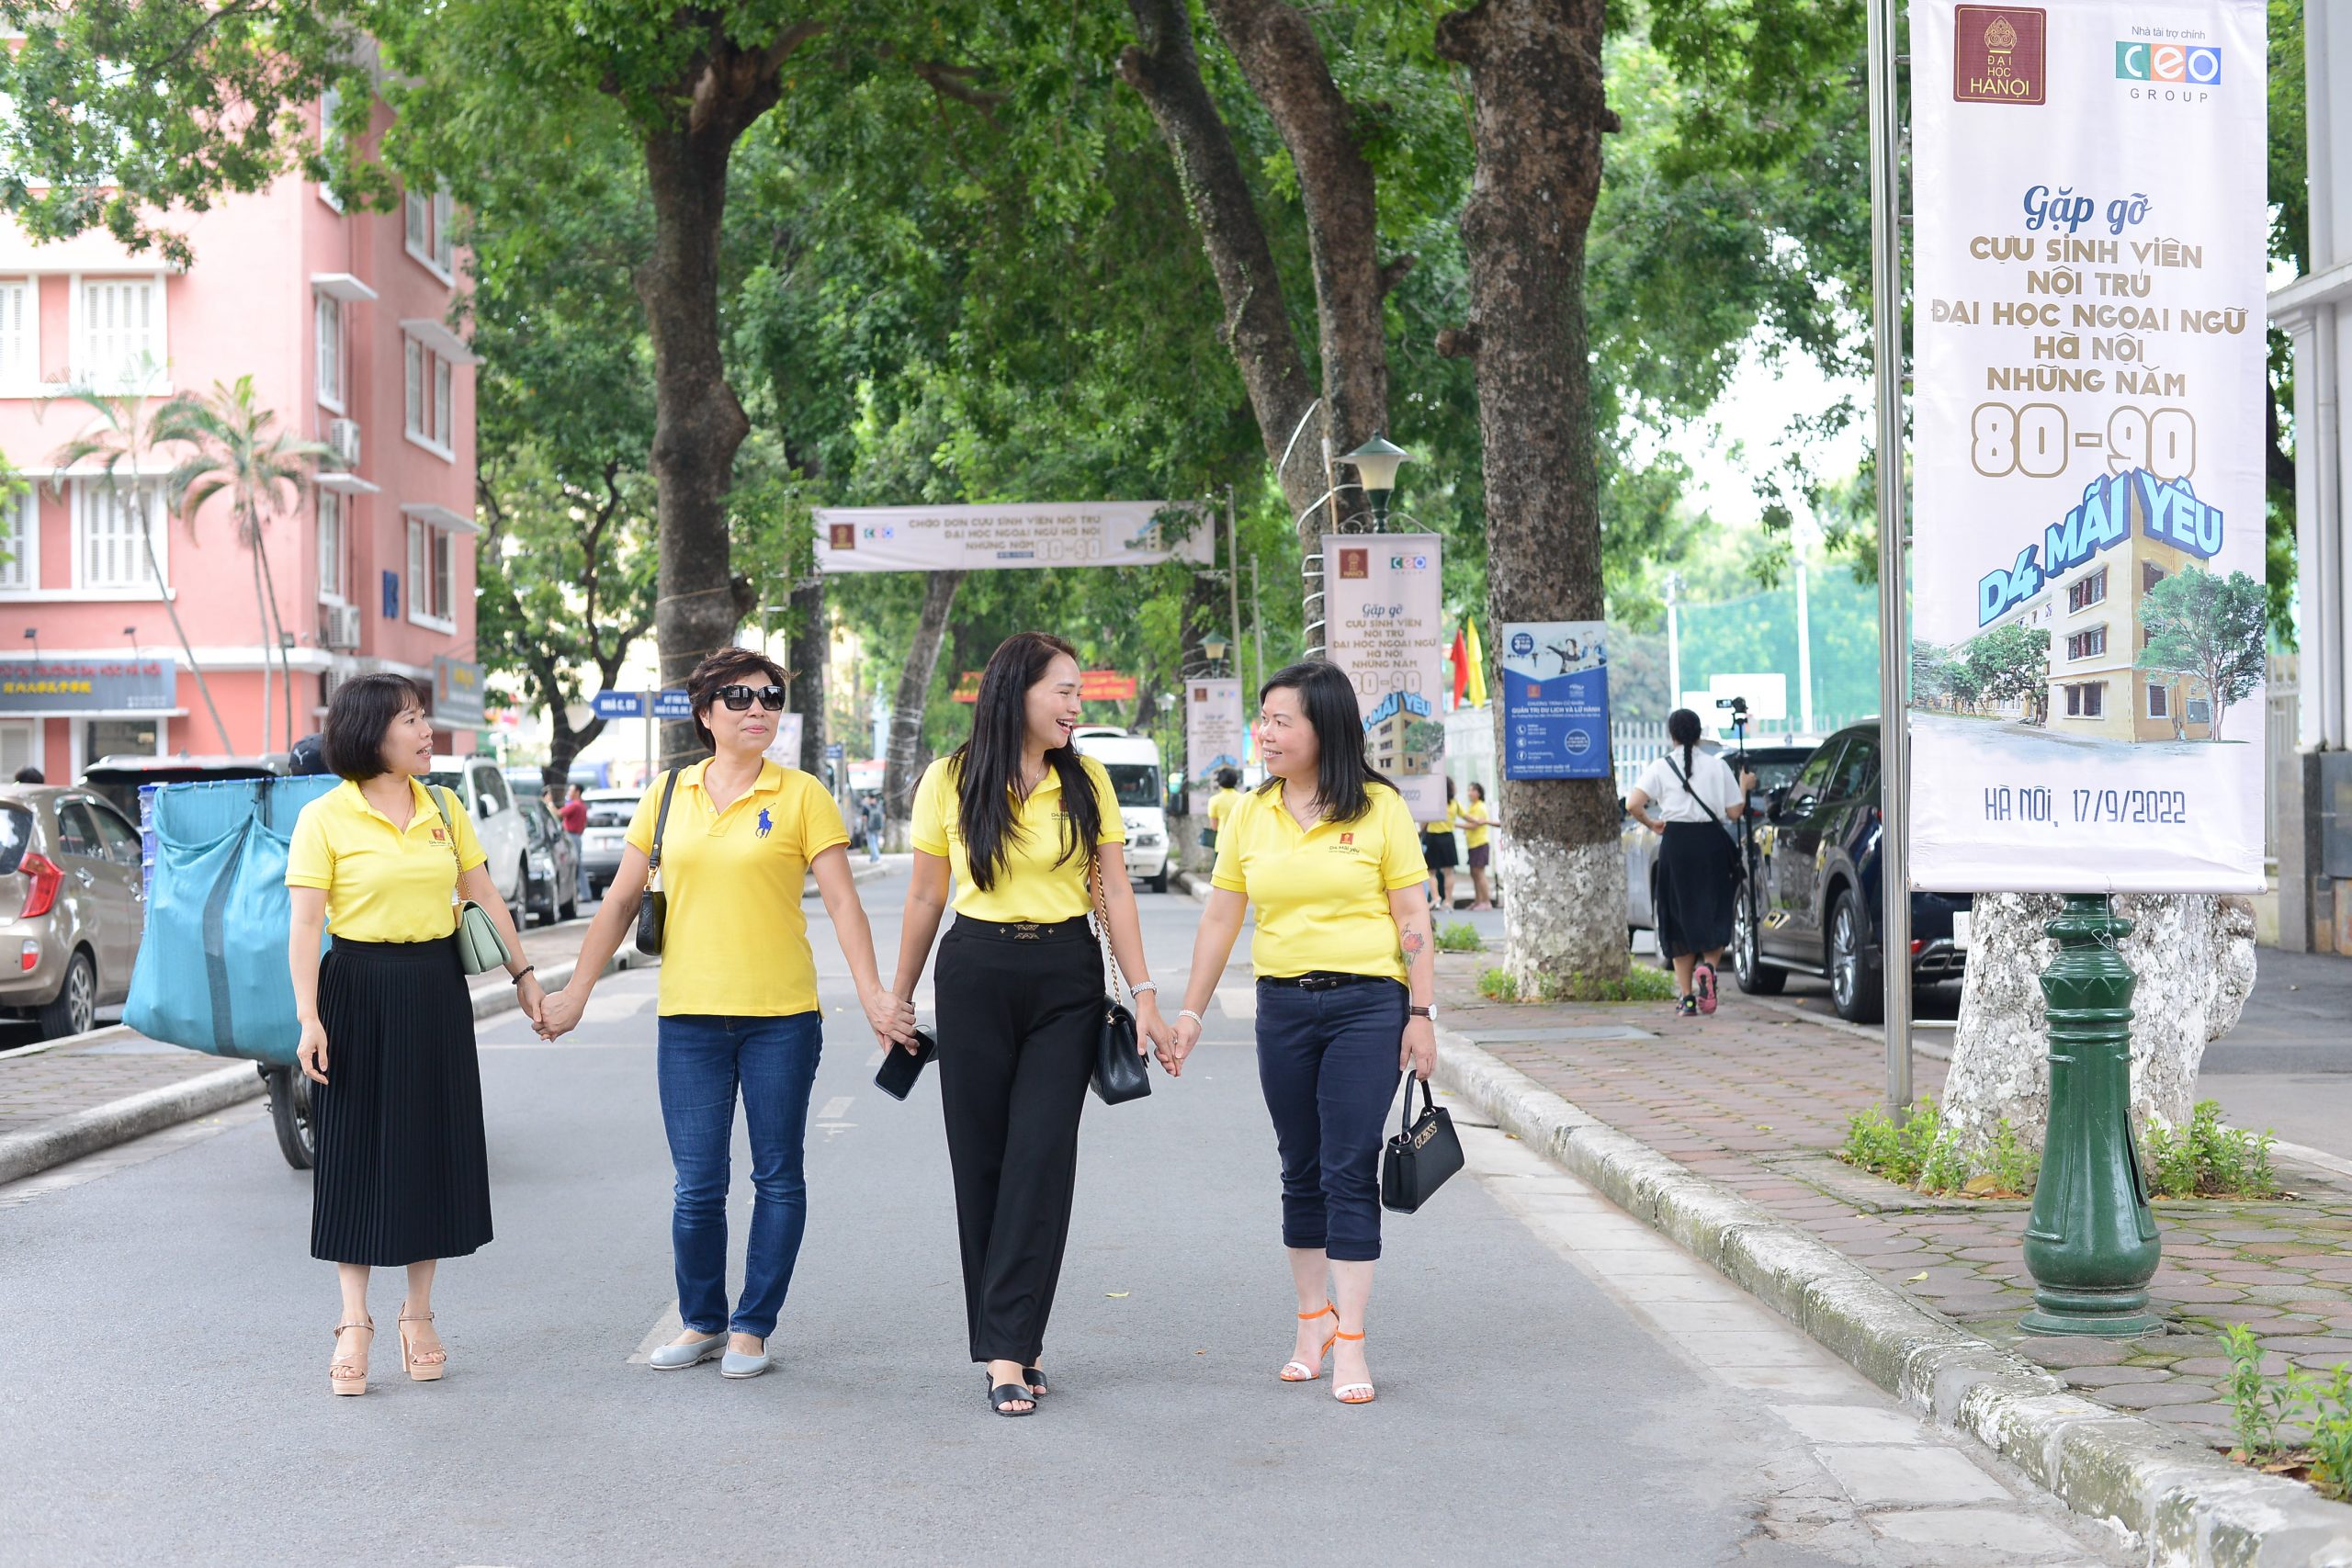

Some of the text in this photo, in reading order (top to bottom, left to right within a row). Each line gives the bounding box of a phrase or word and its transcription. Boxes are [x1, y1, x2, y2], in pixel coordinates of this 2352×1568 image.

[2132, 26, 2205, 39] Nhà tài trợ chính
[1987, 55, 2011, 66] ĐẠI
[1987, 66, 2011, 78] HỌC
[2130, 88, 2208, 103] GROUP
[2023, 185, 2153, 235] Gặp gỡ
[1970, 235, 2034, 264] CỰU
[2028, 265, 2151, 298] NỘI TRÚ
[1931, 299, 2248, 334] ĐẠI HỌC NGOẠI NGŨ
[2092, 332, 2143, 366] NỘI
[1987, 364, 2186, 397] NHỮNG NĂM
[1971, 401, 2196, 481] 80-90
[1978, 467, 2223, 628] D4 MÃI YÊU
[1984, 784, 2011, 821] HÀ
[2073, 789, 2186, 823] 17/9/2022
